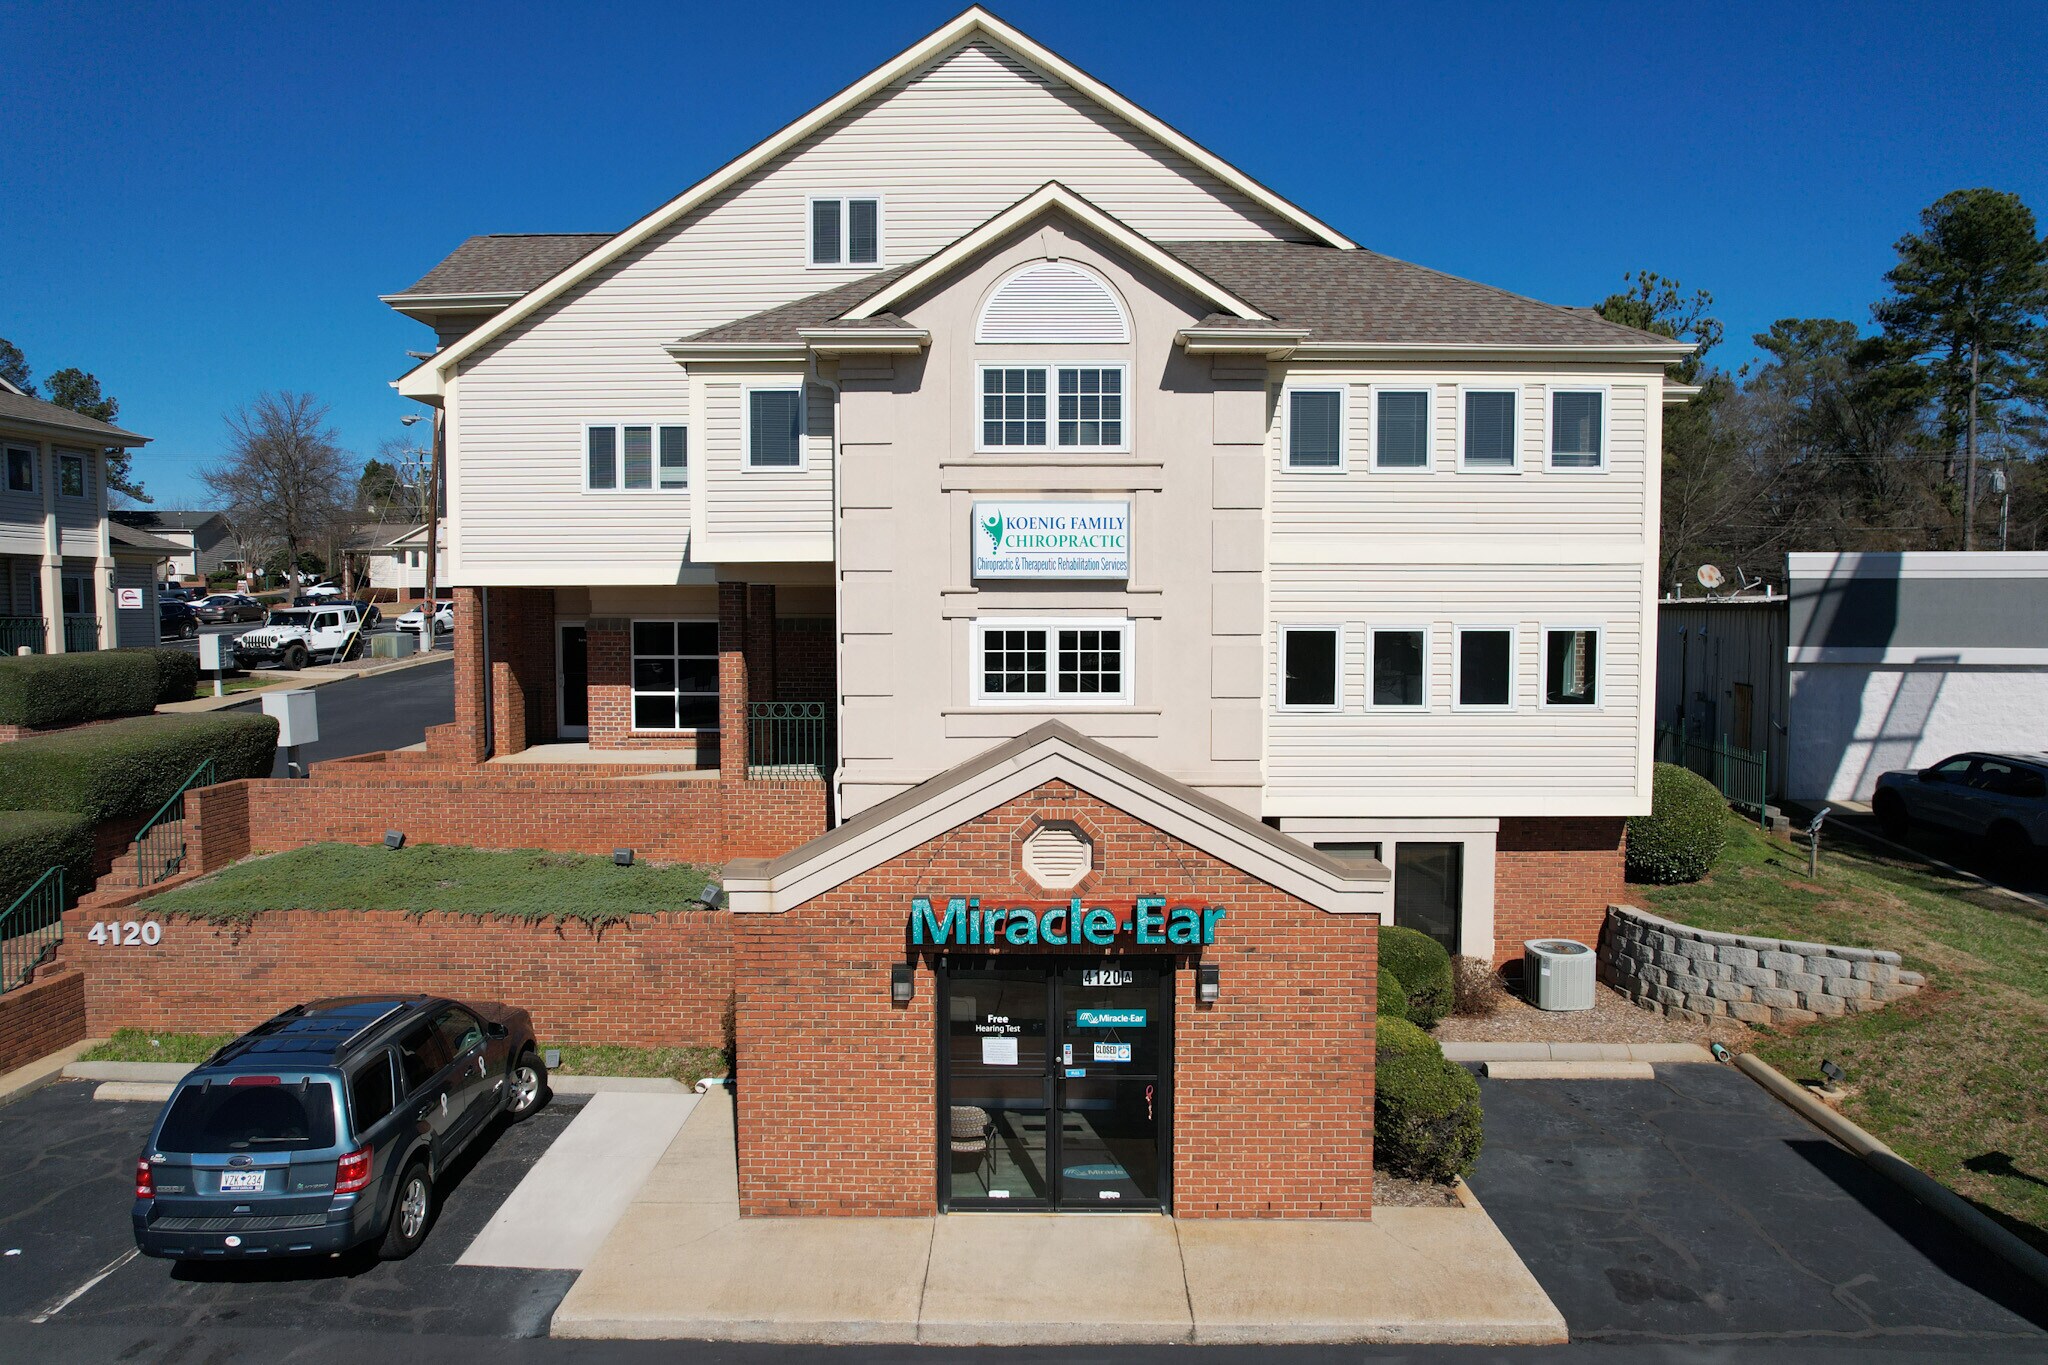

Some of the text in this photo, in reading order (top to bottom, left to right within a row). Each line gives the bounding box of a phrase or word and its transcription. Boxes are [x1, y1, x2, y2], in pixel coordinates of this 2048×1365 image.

[1006, 516, 1126, 530] KOENIG FAMILY
[1005, 534, 1126, 548] CHIROPRACTIC
[977, 557, 1128, 572] Chiropractic & Therapeutic Rehabilitation Services
[87, 921, 161, 946] 4120
[1084, 970, 1121, 985] 4120
[987, 1014, 1009, 1024] Free
[975, 1024, 1021, 1034] Hearing Test
[1095, 1045, 1117, 1055] CLOSED
